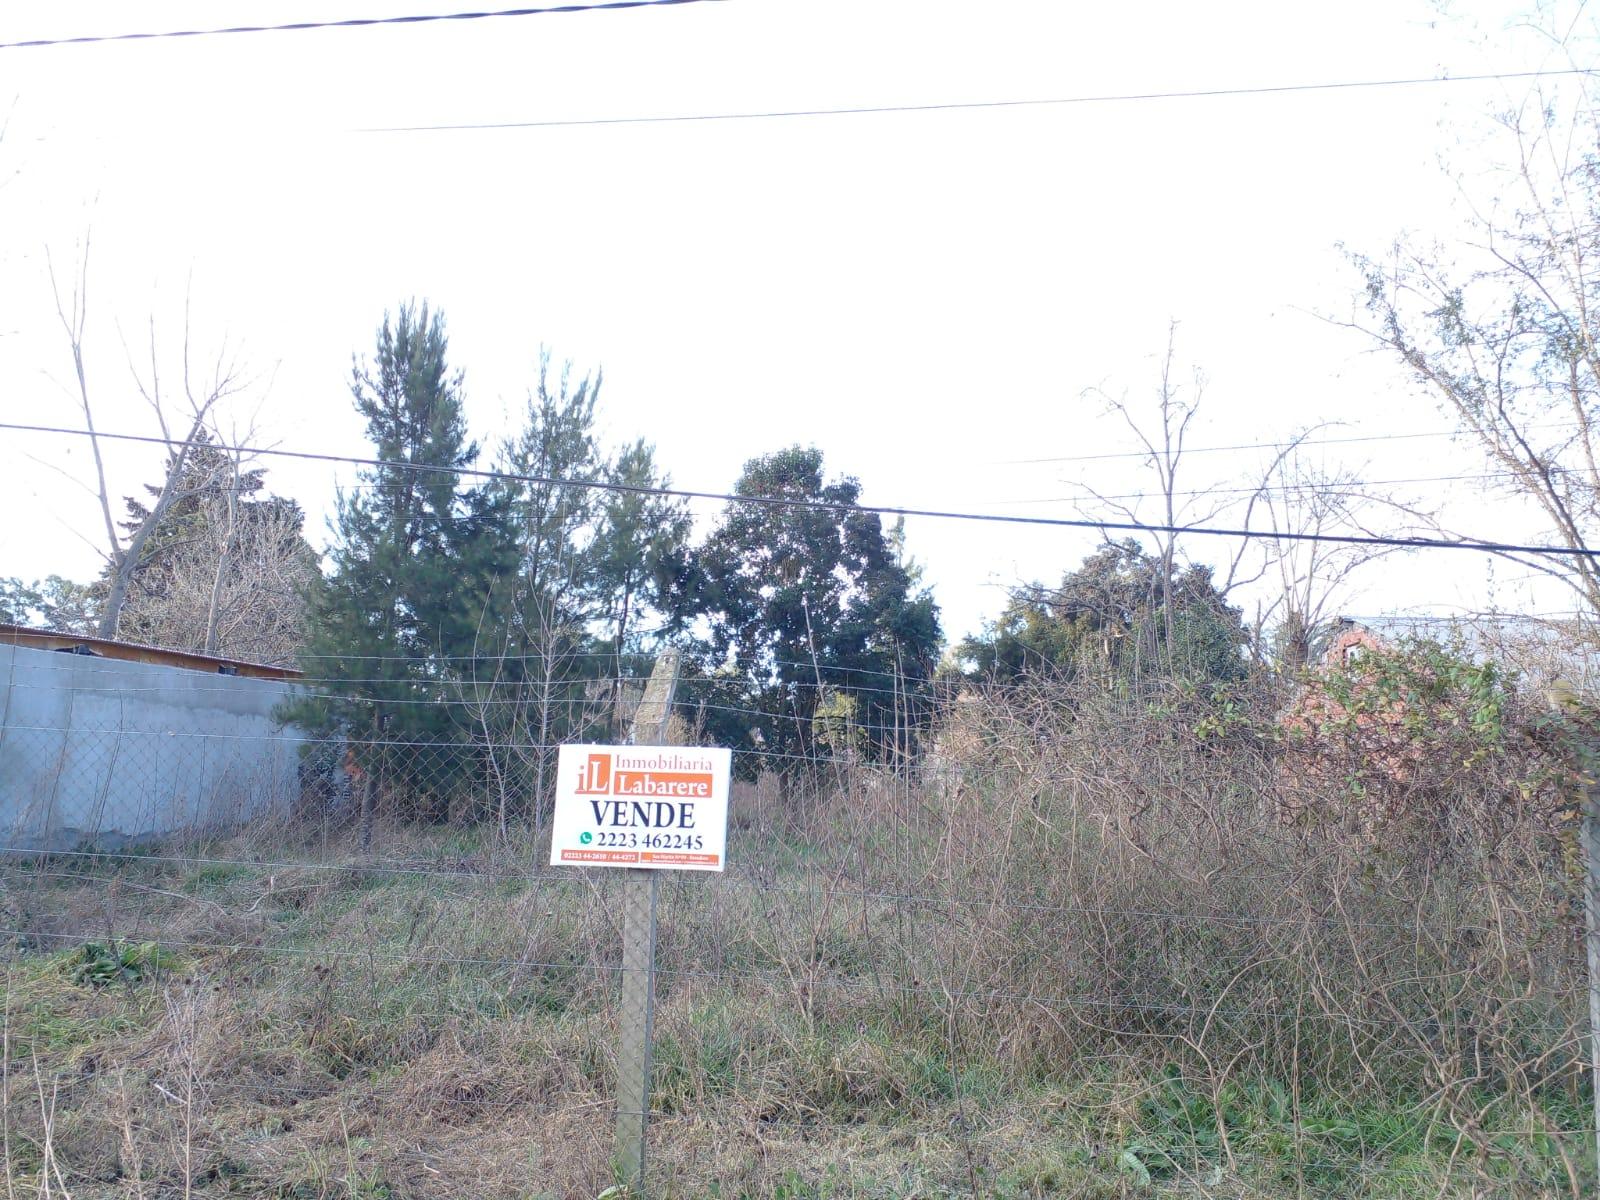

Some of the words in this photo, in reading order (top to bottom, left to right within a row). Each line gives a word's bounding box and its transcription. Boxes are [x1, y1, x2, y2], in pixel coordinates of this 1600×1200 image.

[616, 754, 713, 771] Inmobiliaria
[618, 774, 709, 796] Labarere
[590, 800, 696, 829] VENDE
[597, 832, 638, 848] 2223
[641, 833, 703, 851] 462245
